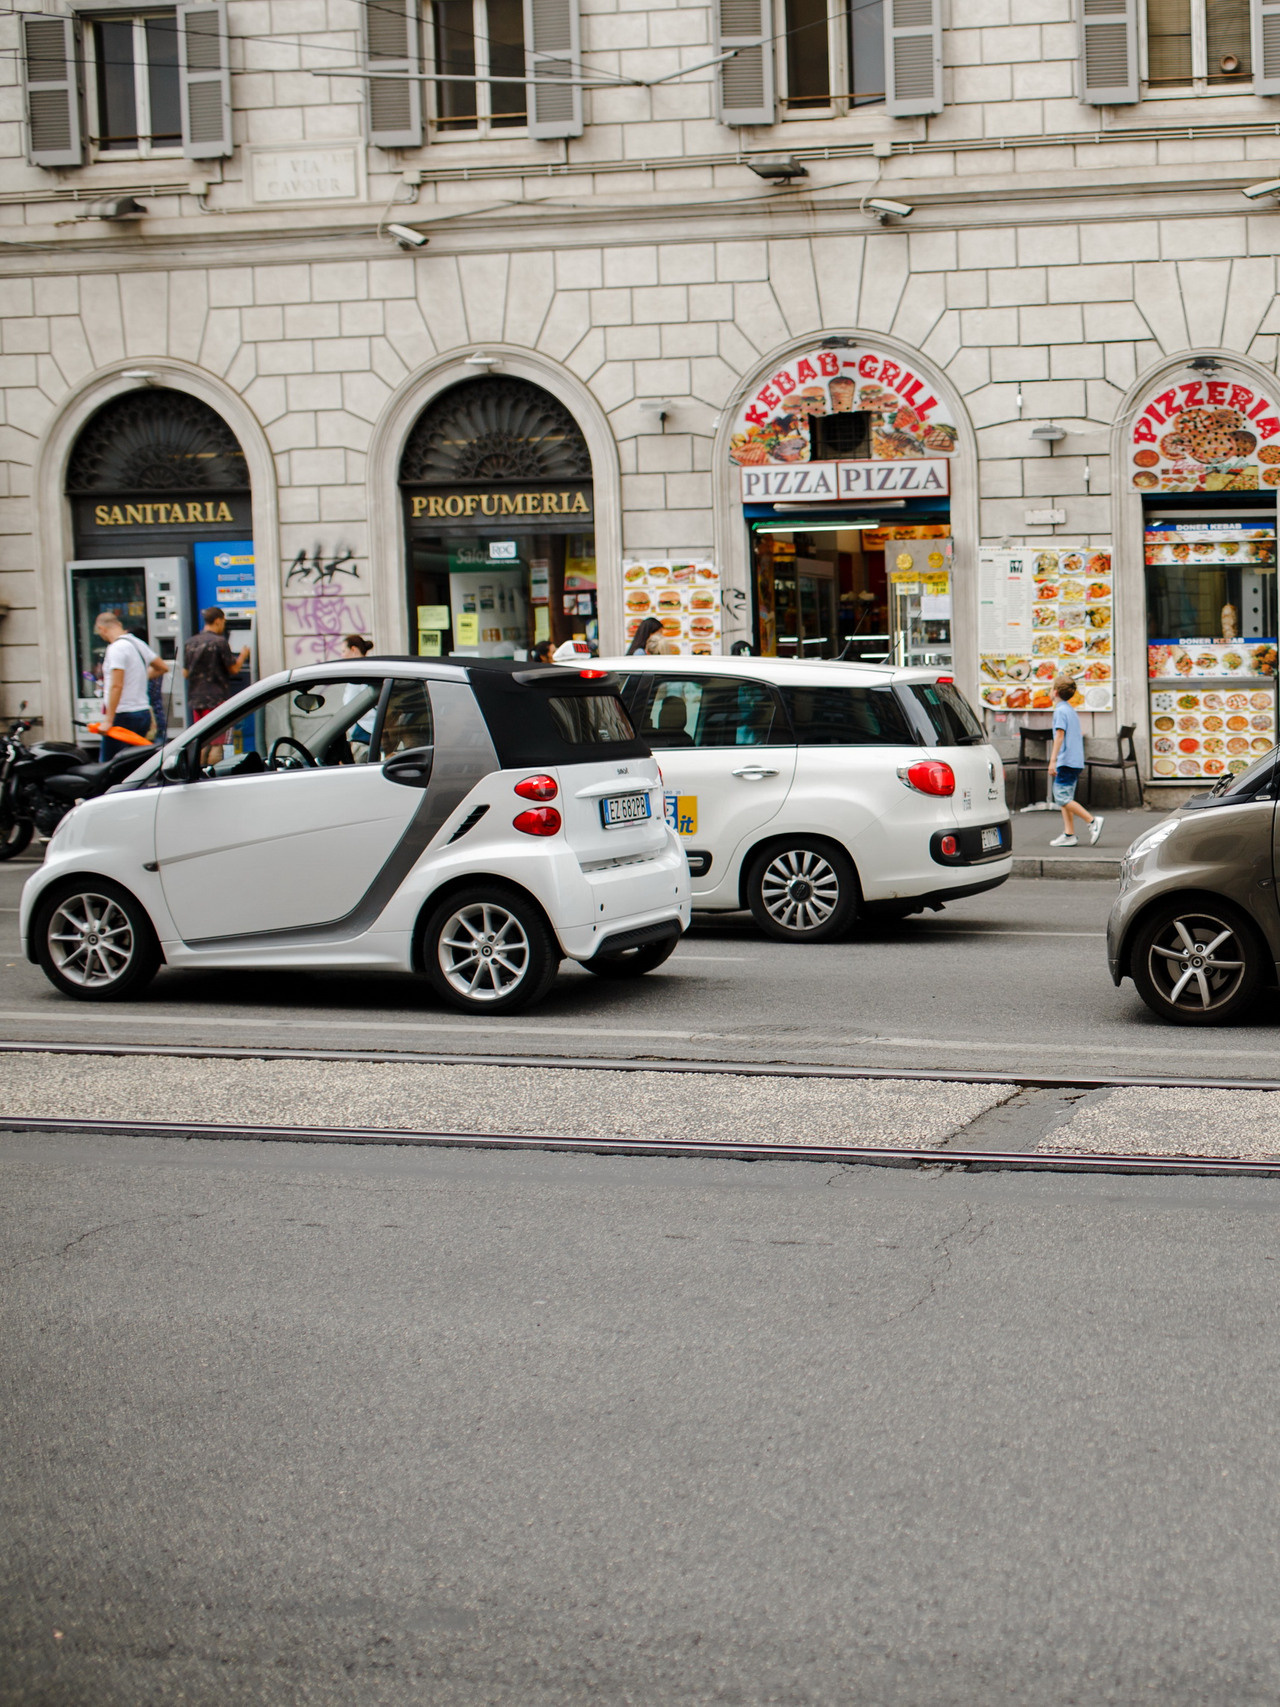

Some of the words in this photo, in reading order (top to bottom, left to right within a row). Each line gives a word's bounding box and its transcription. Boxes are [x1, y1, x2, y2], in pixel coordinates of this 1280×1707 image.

[291, 159, 320, 173] VIA
[267, 178, 341, 195] CAVOUR
[745, 352, 938, 428] KEBAB-GRILL
[744, 471, 833, 496] PIZZA
[842, 467, 944, 492] PIZZA
[95, 502, 234, 525] SANITARIA
[411, 492, 590, 518] PROFUMERIA
[609, 800, 621, 820] EZ
[622, 797, 646, 818] 682PB
